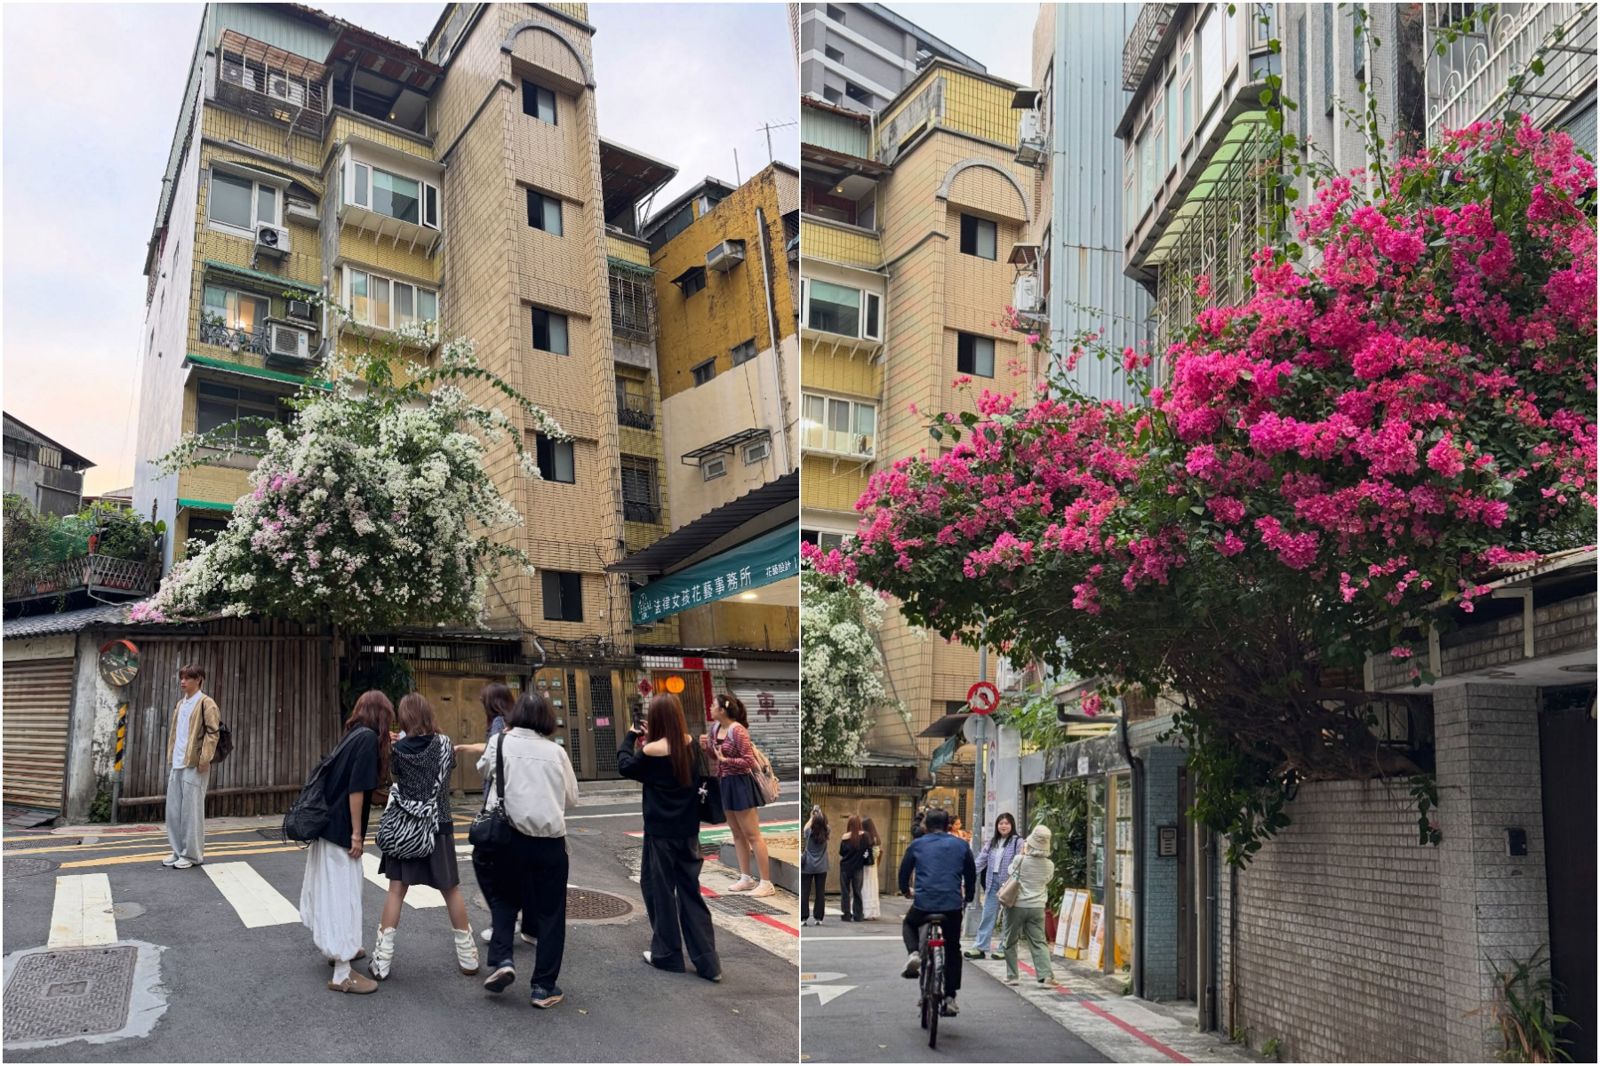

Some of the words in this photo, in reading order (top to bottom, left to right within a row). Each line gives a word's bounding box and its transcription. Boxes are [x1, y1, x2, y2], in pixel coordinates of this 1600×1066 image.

[653, 565, 752, 615] 法律女孩花藝事務所
[757, 692, 779, 723] 車
